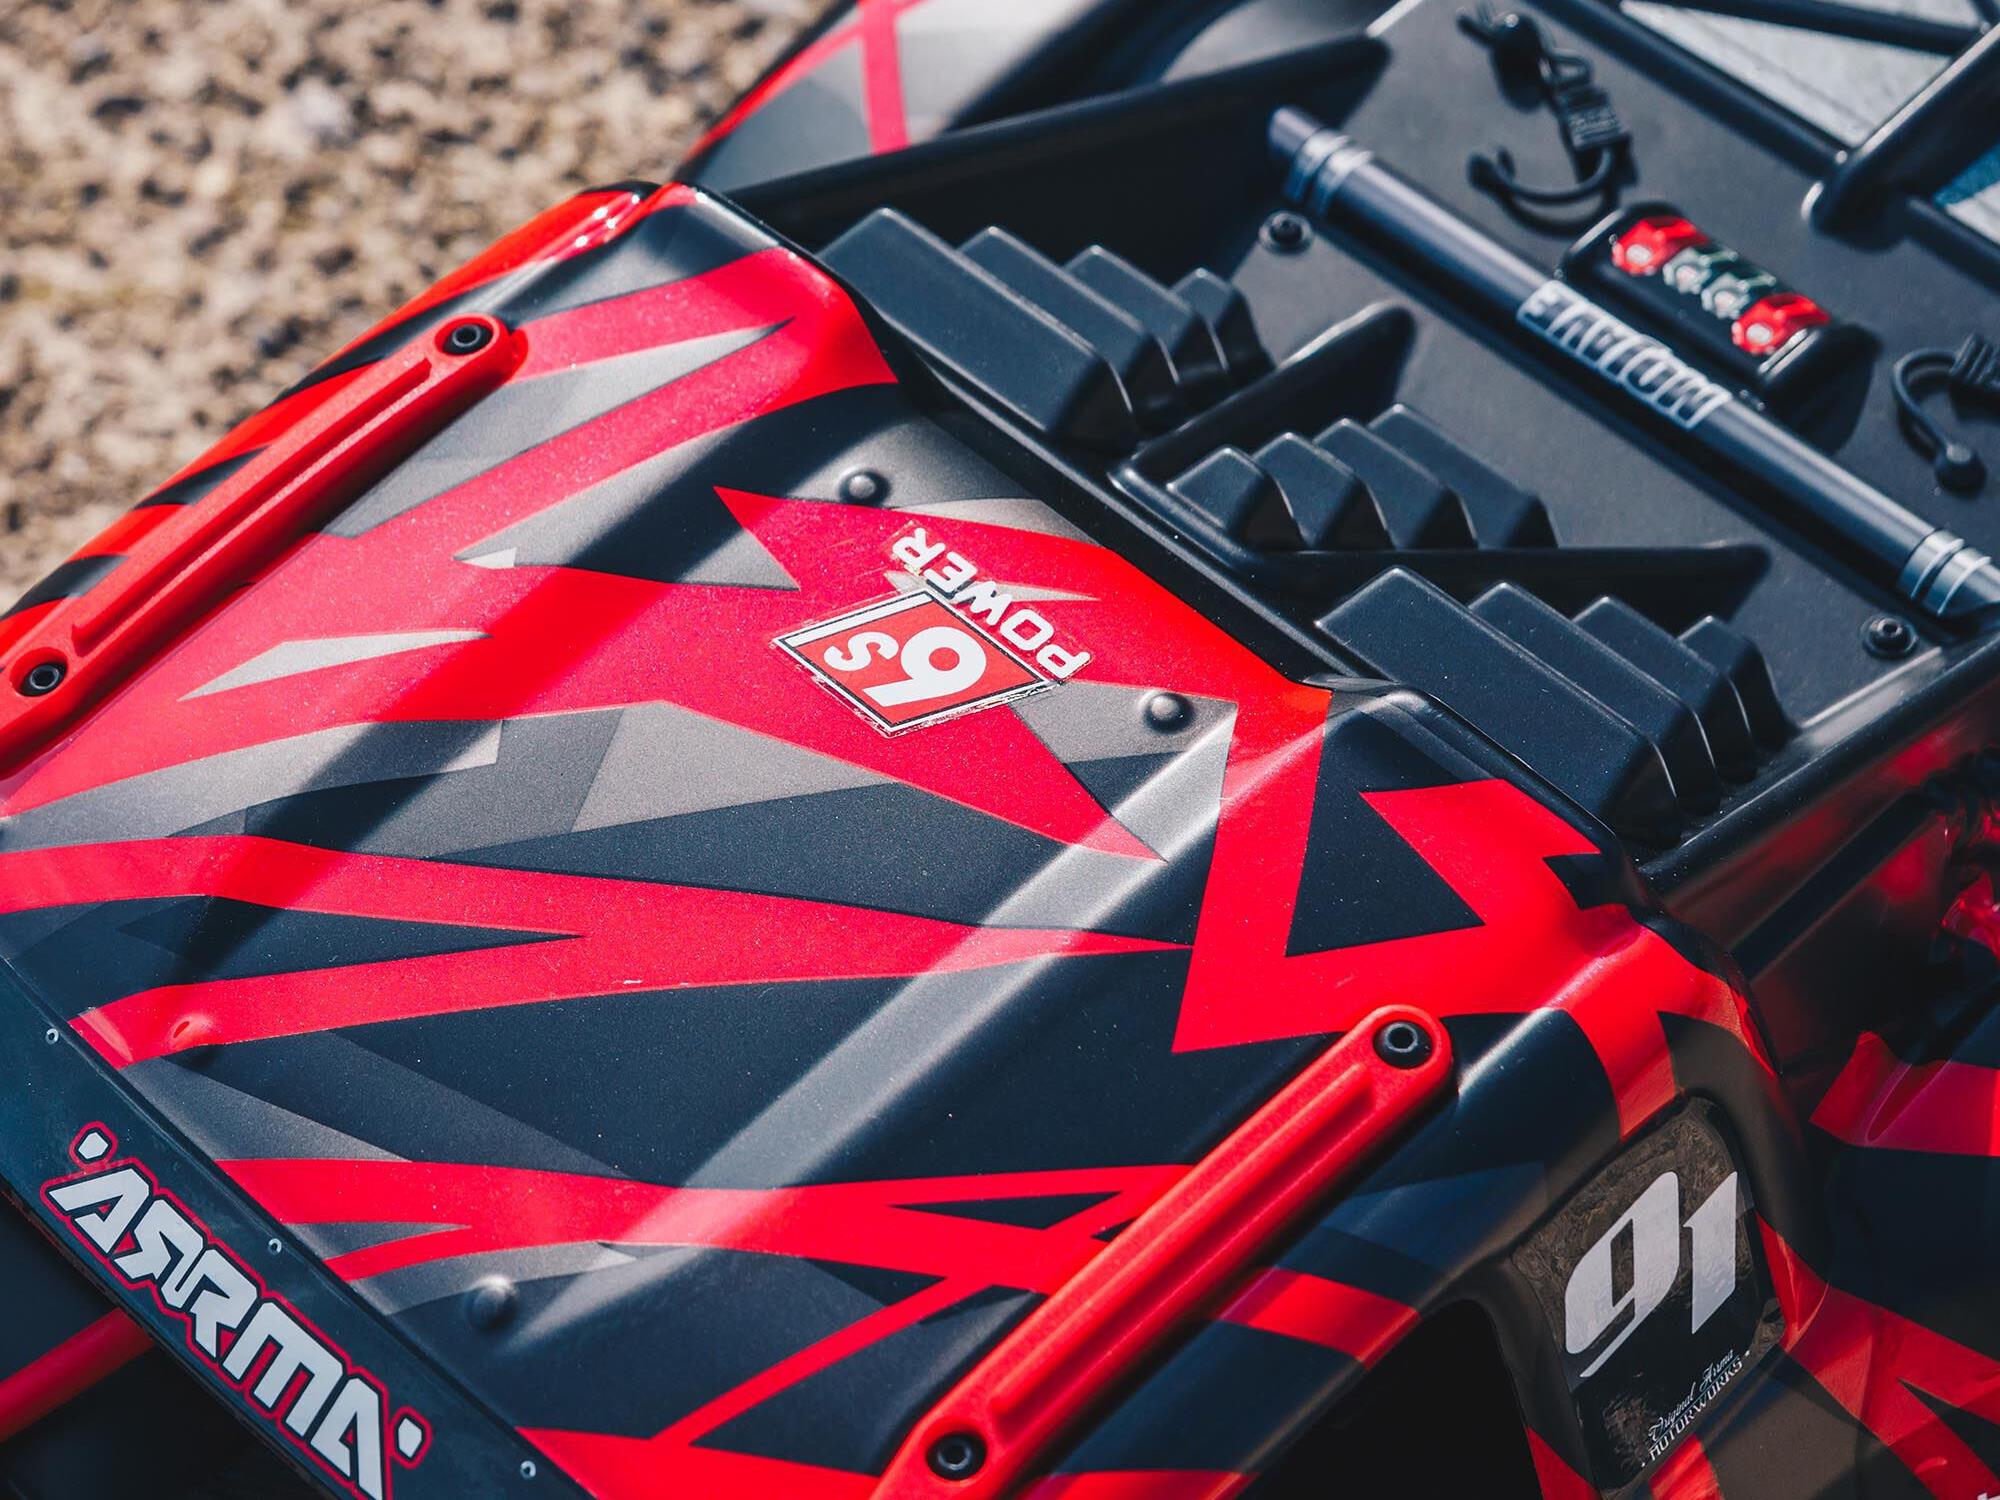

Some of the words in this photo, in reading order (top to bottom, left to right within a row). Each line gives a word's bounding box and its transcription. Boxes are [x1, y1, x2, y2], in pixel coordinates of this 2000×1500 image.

[1518, 280, 1731, 429] MOJAVE
[892, 527, 1091, 679] POWER
[1564, 1170, 1738, 1378] 91
